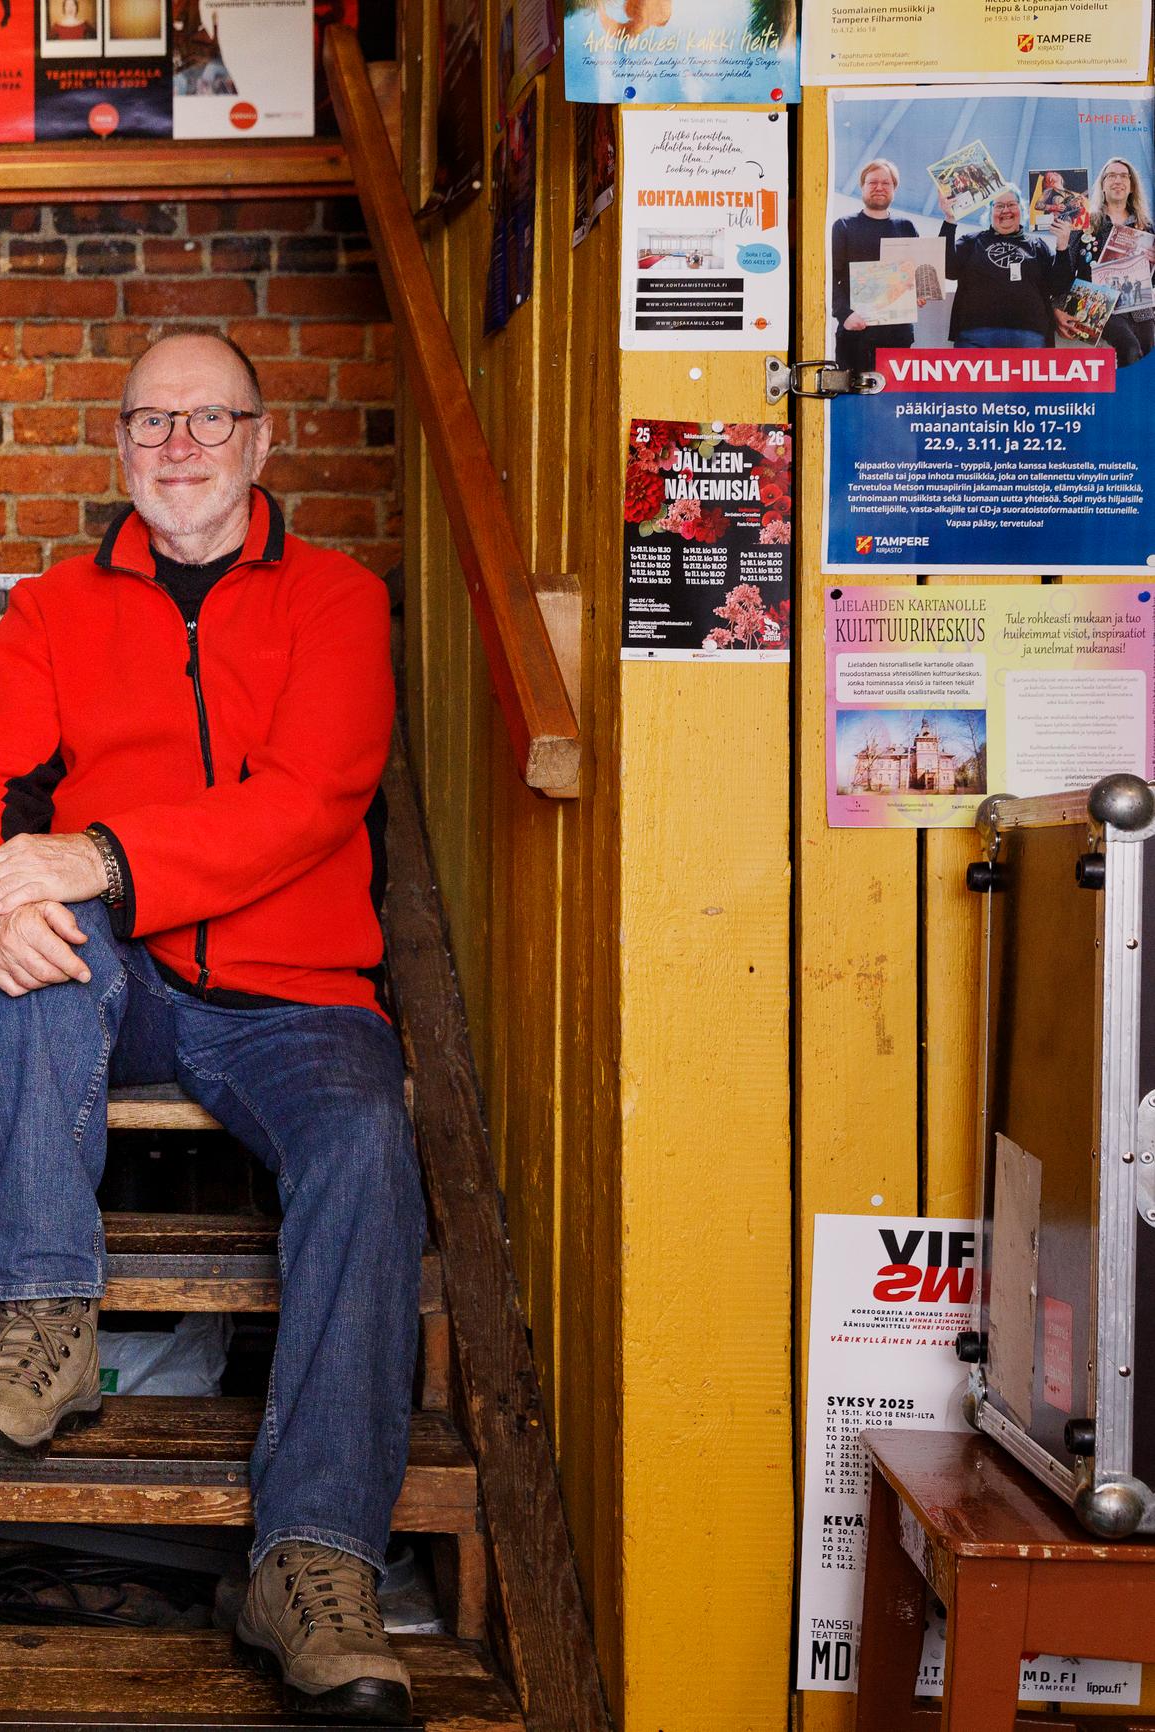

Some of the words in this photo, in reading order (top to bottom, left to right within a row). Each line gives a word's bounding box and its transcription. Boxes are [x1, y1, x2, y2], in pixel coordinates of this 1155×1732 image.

[926, 6, 935, 15] ja
[985, 5, 1012, 13] Heppu
[1024, 4, 1068, 13] Lopunajan
[1070, 3, 1108, 11] Voidellut
[832, 16, 870, 25] Tampere
[871, 14, 922, 23] Filharmonia
[686, 26, 736, 53] kaikki
[740, 22, 780, 54] heitä
[1037, 34, 1092, 44] TAMPERE
[638, 190, 754, 208] KOHTAAMISTEN
[727, 208, 754, 229] tila
[888, 360, 1105, 382] VINYYLI-ILLAT
[896, 402, 978, 418] pääkirjasto
[982, 403, 1030, 418] Metso,
[1034, 402, 1096, 416] musiikki
[910, 421, 1009, 434] maanantaisin
[1013, 420, 1035, 433] klo
[636, 427, 651, 443] 25
[768, 430, 784, 446] 26
[924, 438, 963, 453] 22.9.,
[967, 438, 1002, 451] 3.11.
[1004, 438, 1019, 454] ja
[1023, 438, 1066, 451] 22.12.
[672, 447, 753, 474] JÄLLEEN-
[854, 462, 896, 471] Kaipaatko
[897, 462, 953, 471] vinyylikaveria
[960, 462, 993, 471] tyyppiä,
[994, 462, 1018, 472] jonka
[1018, 462, 1046, 470] kanssa
[1048, 462, 1096, 471] keskustella,
[1098, 462, 1138, 471] muistella,
[859, 472, 894, 480] ihastella
[896, 472, 906, 480] tai
[908, 472, 926, 482] jopa
[928, 472, 954, 480] inhota
[956, 472, 996, 482] musiikkia,
[998, 473, 1016, 482] joka
[1030, 473, 1076, 481] tallennettu
[1076, 473, 1108, 483] vinyylin
[1110, 473, 1134, 481] uriin?
[664, 474, 761, 500] NÄKEMISIÄ
[850, 505, 908, 515] ihmettelijöille,
[910, 505, 966, 515] vasta-alkajille
[1002, 506, 1094, 514] suoratoistoformaattiin
[1096, 506, 1140, 514] tottuneille.
[946, 520, 971, 528] Vapaa
[972, 519, 998, 529] pääsy,
[1000, 520, 1044, 528] tervetuloa!
[874, 536, 930, 546] TAMPERE
[835, 599, 905, 612] LIELAHDEN
[908, 598, 986, 612] KARTANOLLE
[1006, 612, 1026, 624] Tule
[1028, 611, 1071, 624] rohkeasti
[1073, 610, 1112, 624] mukaan
[1112, 614, 1124, 626] ja
[1126, 614, 1142, 624] tuo
[836, 617, 986, 642] KULTTUURIKESKUS
[1003, 627, 1061, 640] huikeimmat
[1062, 628, 1090, 640] visiot,
[1092, 628, 1146, 642] inspiraatiot
[1021, 644, 1032, 658] ja
[1034, 642, 1074, 655] unelmat
[1076, 642, 1126, 655] mukanasi!
[852, 1308, 903, 1316] KOREOGRAFIA
[915, 1310, 943, 1318] OHJAUS
[842, 1320, 910, 1330] ÄÄNISUUNNITTELU
[830, 1334, 912, 1346] VÄRIKYLLÄINEN
[916, 1338, 927, 1346] JA
[827, 1396, 876, 1408] SYKSY
[880, 1398, 914, 1410] 2025
[826, 1408, 837, 1416] LA
[866, 1410, 882, 1418] KLO
[896, 1412, 935, 1420] ENSI-ILTA
[840, 1444, 862, 1452] 22.11.
[840, 1452, 862, 1460] 25.11.
[824, 1514, 864, 1527] KEVÄ
[838, 1528, 858, 1536] 30.1.
[822, 1544, 834, 1552] TO
[836, 1554, 856, 1562] 13.2.
[822, 1562, 832, 1570] LA
[811, 1618, 853, 1630] TANSSI
[810, 1630, 853, 1641] TEATTERI
[810, 1640, 852, 1682] MD
[1034, 1684, 1076, 1692] TAMPERE
